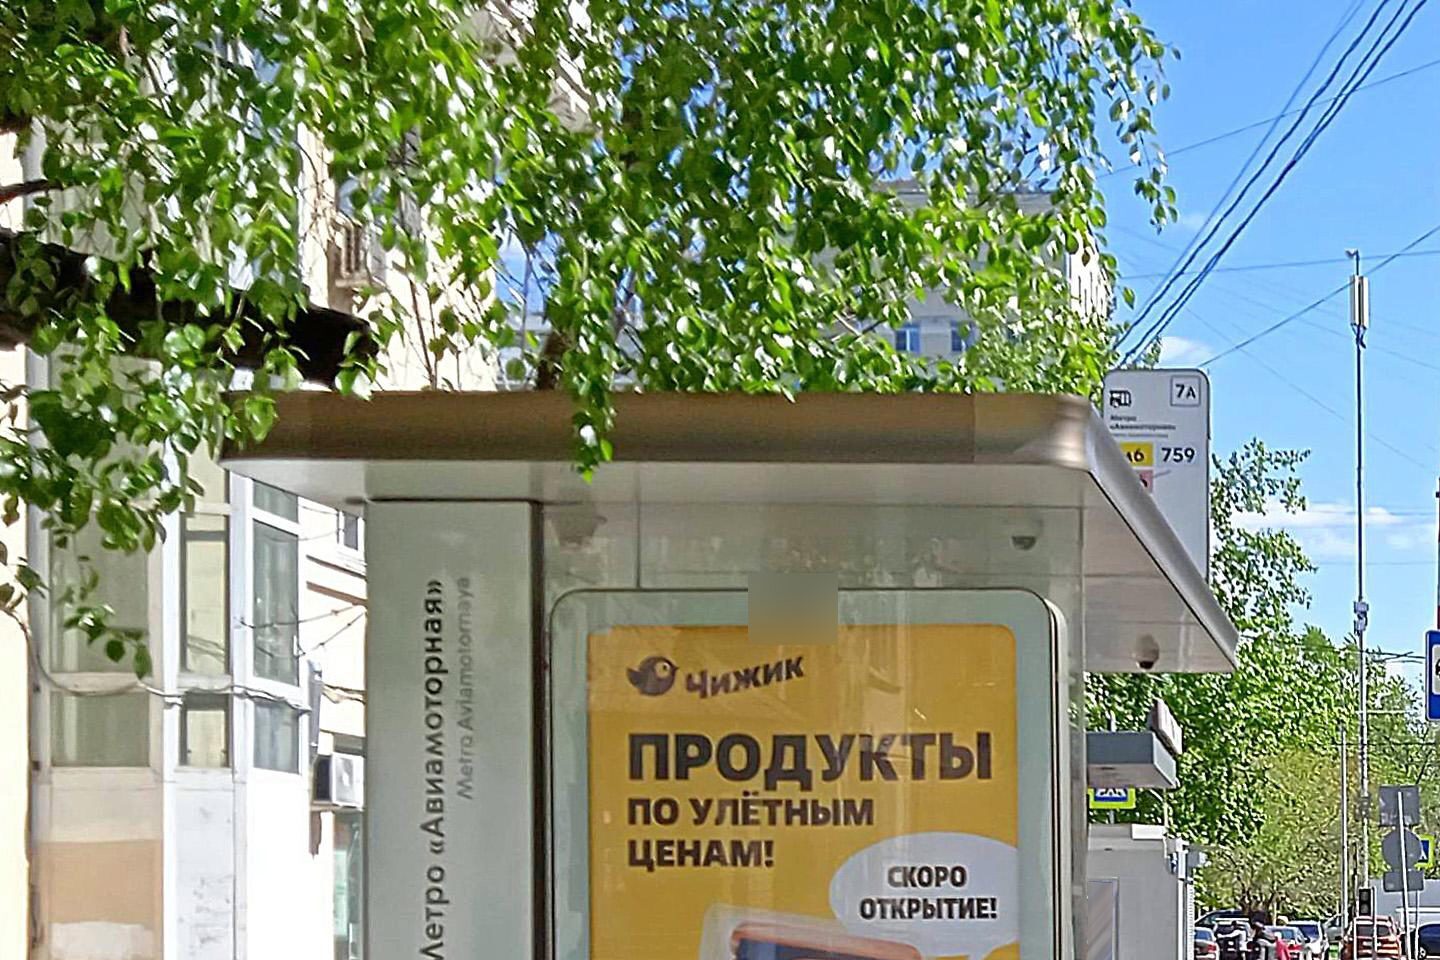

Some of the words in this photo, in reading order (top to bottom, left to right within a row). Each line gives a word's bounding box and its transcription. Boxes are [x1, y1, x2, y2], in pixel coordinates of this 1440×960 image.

[1161, 447, 1196, 463] 759
[418, 579, 450, 855] «Авиамоторная»
[627, 732, 993, 791] ПРОДУКТЫ
[627, 797, 679, 826] ПО
[692, 790, 874, 826] УЛЁТНЫМ
[627, 839, 774, 872] ЦЕНАМ!
[887, 865, 968, 888] СКОРО
[858, 897, 998, 921] ОТКРЫТИЕ!
